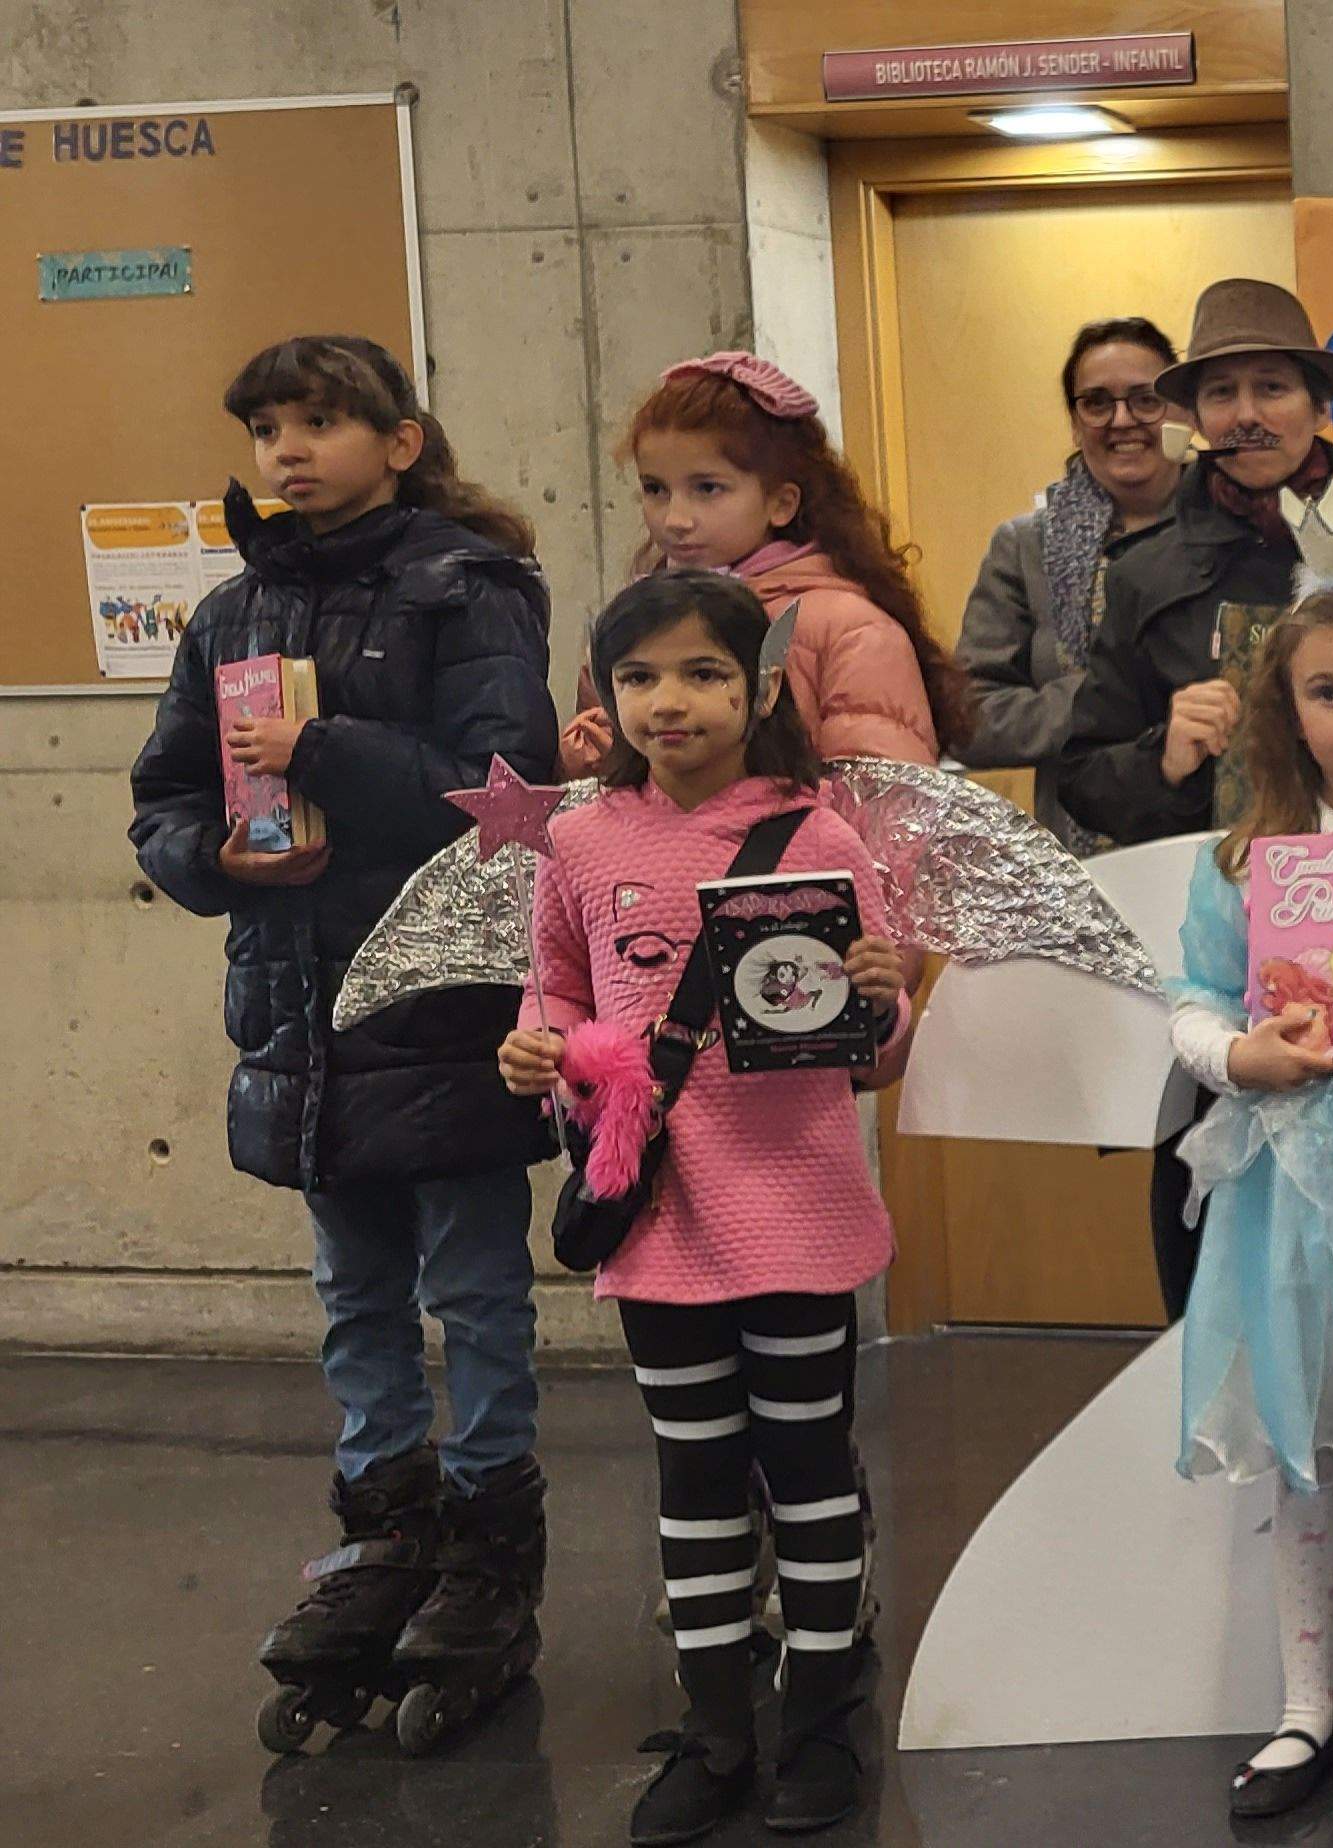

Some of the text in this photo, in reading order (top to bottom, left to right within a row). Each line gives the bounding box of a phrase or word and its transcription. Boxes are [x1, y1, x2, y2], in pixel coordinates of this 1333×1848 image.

[875, 59, 963, 85] BIBLIOTECA
[964, 51, 1019, 79] RAMÓN
[1022, 56, 1037, 77] J.
[1038, 52, 1101, 76] SENDER
[1112, 48, 1184, 73] INFANTIL
[53, 118, 215, 163] HUESCA
